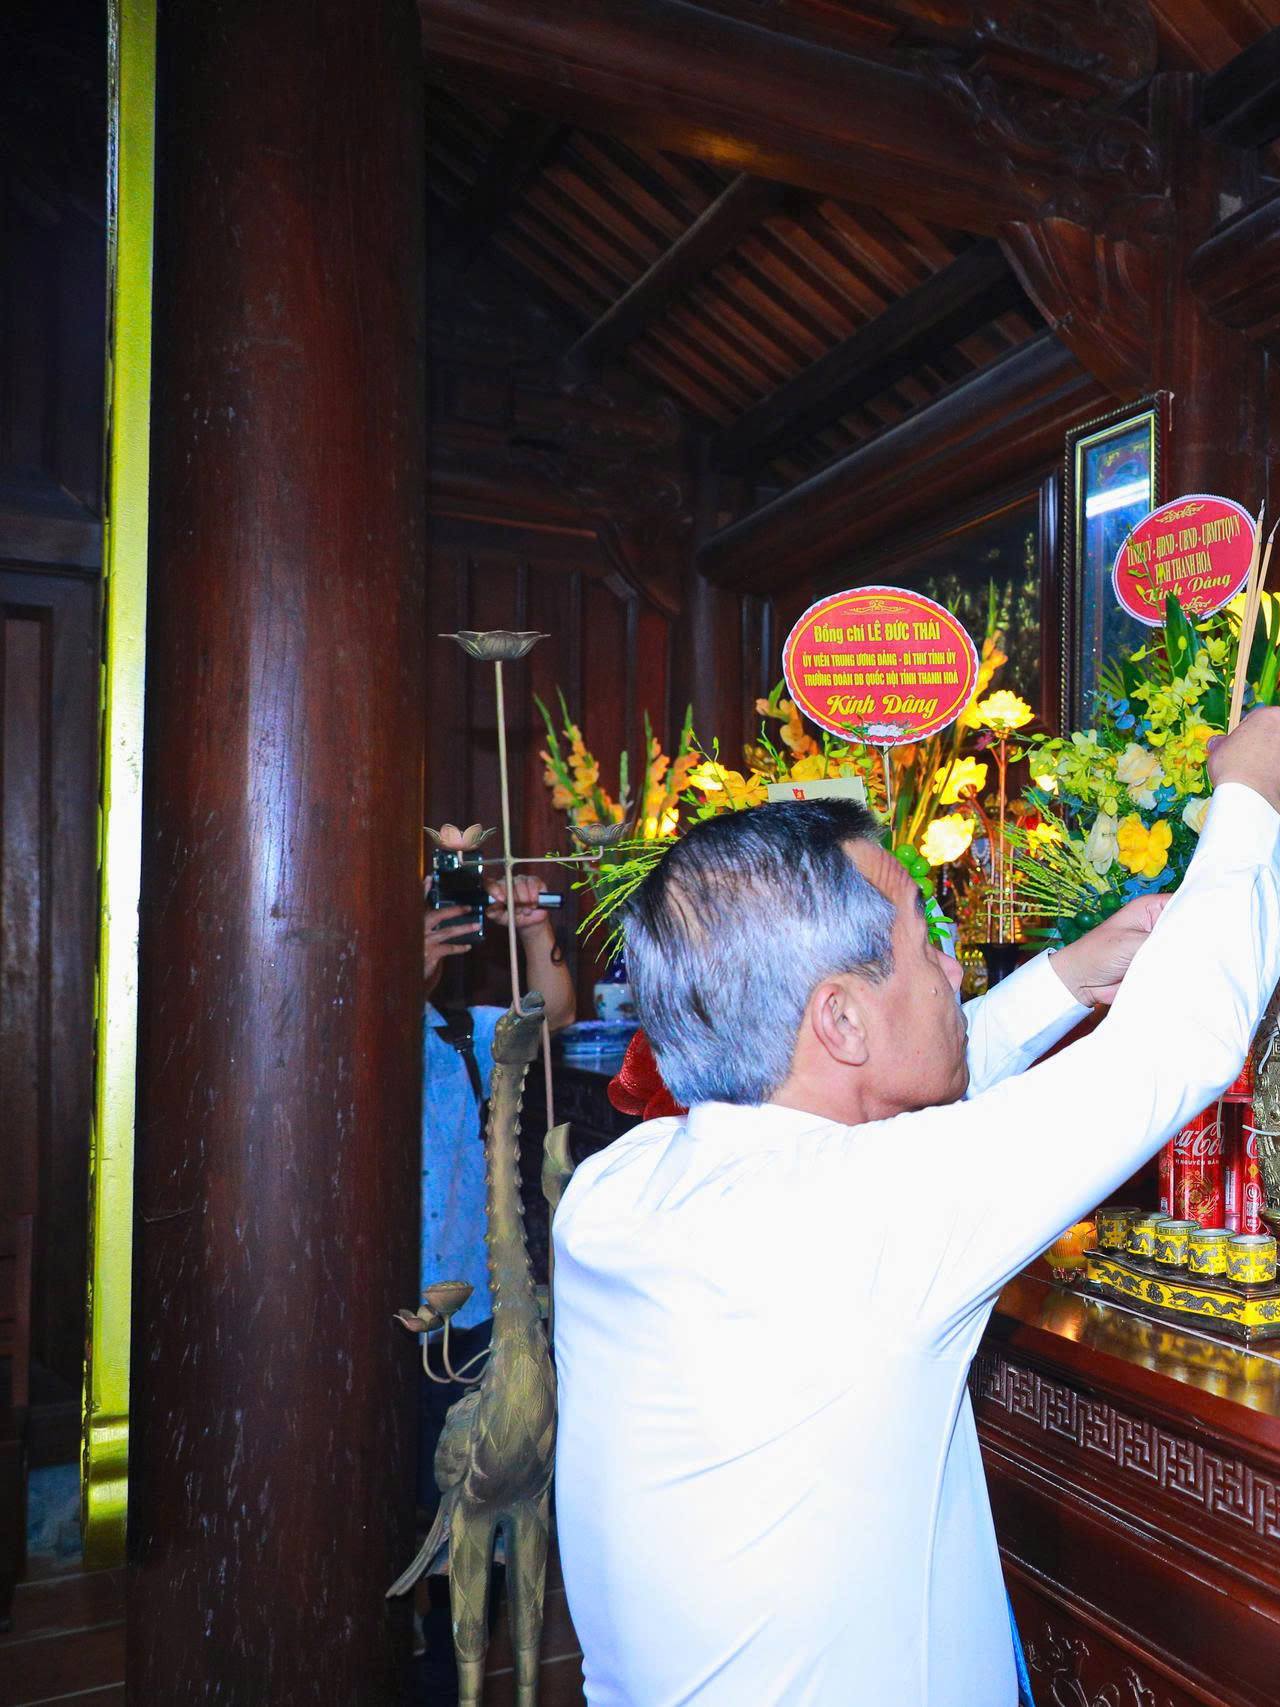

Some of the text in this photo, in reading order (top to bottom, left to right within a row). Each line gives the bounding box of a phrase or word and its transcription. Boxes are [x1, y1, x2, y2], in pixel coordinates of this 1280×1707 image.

[1187, 574, 1231, 593] Dâng
[813, 618, 941, 645] Đồng chí LÊ ĐỨC THÁI
[813, 651, 830, 667] VIÊN
[831, 653, 856, 667] TRUNG
[877, 649, 897, 666] ĐẢNG
[928, 648, 945, 665] TỈNH
[832, 671, 853, 686] ĐOÀN
[865, 668, 885, 687] QUỐC
[900, 668, 917, 685] TỈNH
[917, 671, 942, 685] THANH
[826, 694, 939, 719] Kính Dâng
